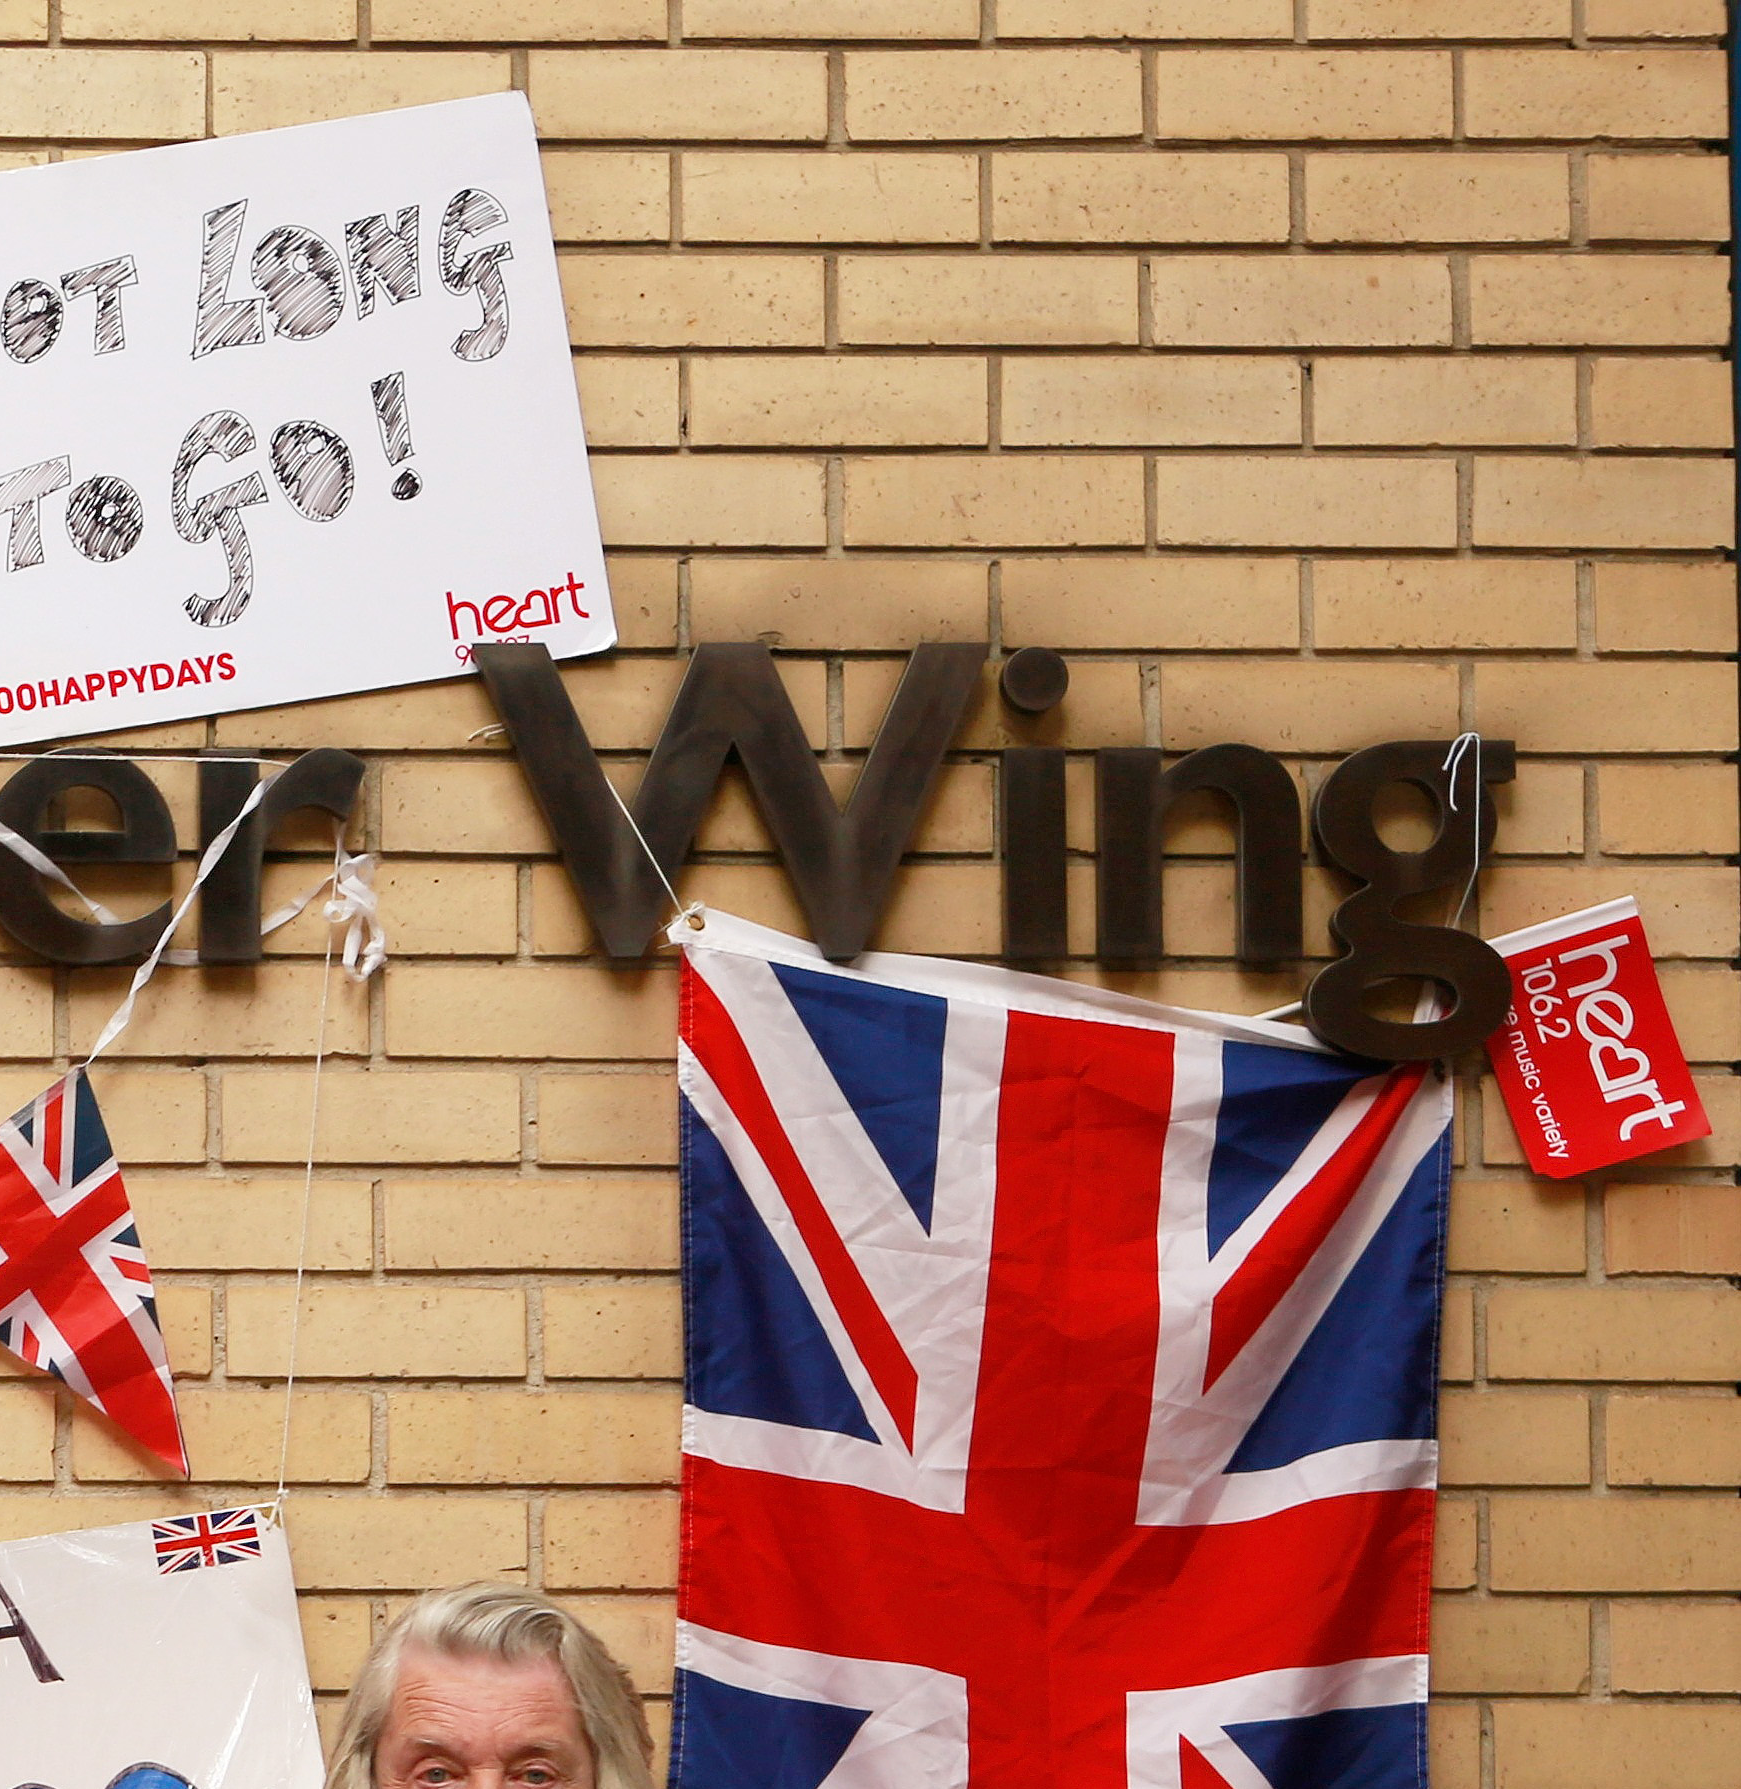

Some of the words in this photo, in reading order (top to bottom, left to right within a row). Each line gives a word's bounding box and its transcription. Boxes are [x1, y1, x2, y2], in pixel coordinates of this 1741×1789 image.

[191, 188, 515, 361] LONG
[170, 370, 424, 628] GO!
[446, 572, 590, 640] heart
[472, 641, 1516, 1061] Wing
[1521, 958, 1571, 1043] 106.2
[1558, 934, 1685, 1141] heart
[1507, 1031, 1540, 1089] music
[1530, 1094, 1569, 1159] variety
